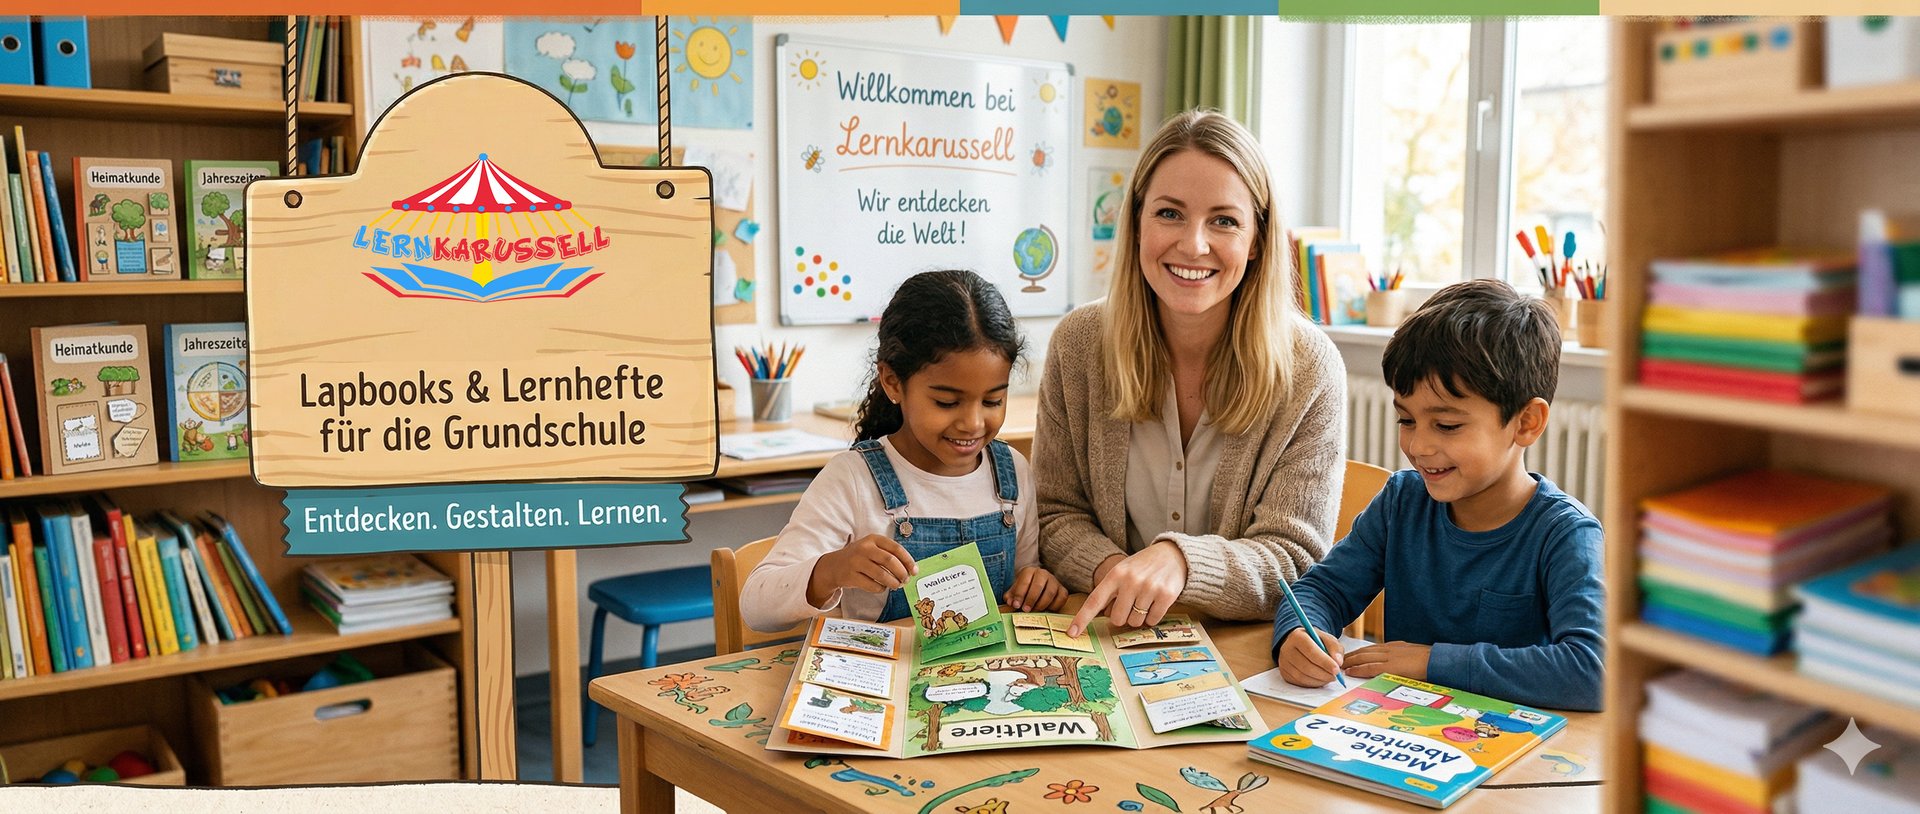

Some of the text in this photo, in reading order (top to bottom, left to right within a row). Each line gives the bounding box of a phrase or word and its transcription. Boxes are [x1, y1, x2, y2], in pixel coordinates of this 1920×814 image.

[837, 70, 1016, 112] Willkommen bei
[836, 115, 1015, 162] Lernkarussell
[91, 171, 161, 184] Heimatkunde
[857, 188, 991, 213] Wir entdecken
[877, 221, 906, 244] die
[55, 341, 134, 357] Heimatkunde
[923, 570, 967, 589] Waldtiere
[951, 722, 1086, 738] Waldtiere
[1305, 719, 1329, 730] 2
[1281, 737, 1302, 748] 2
[1330, 724, 1462, 764] Abenteuer
[1350, 741, 1438, 772] Mathe
